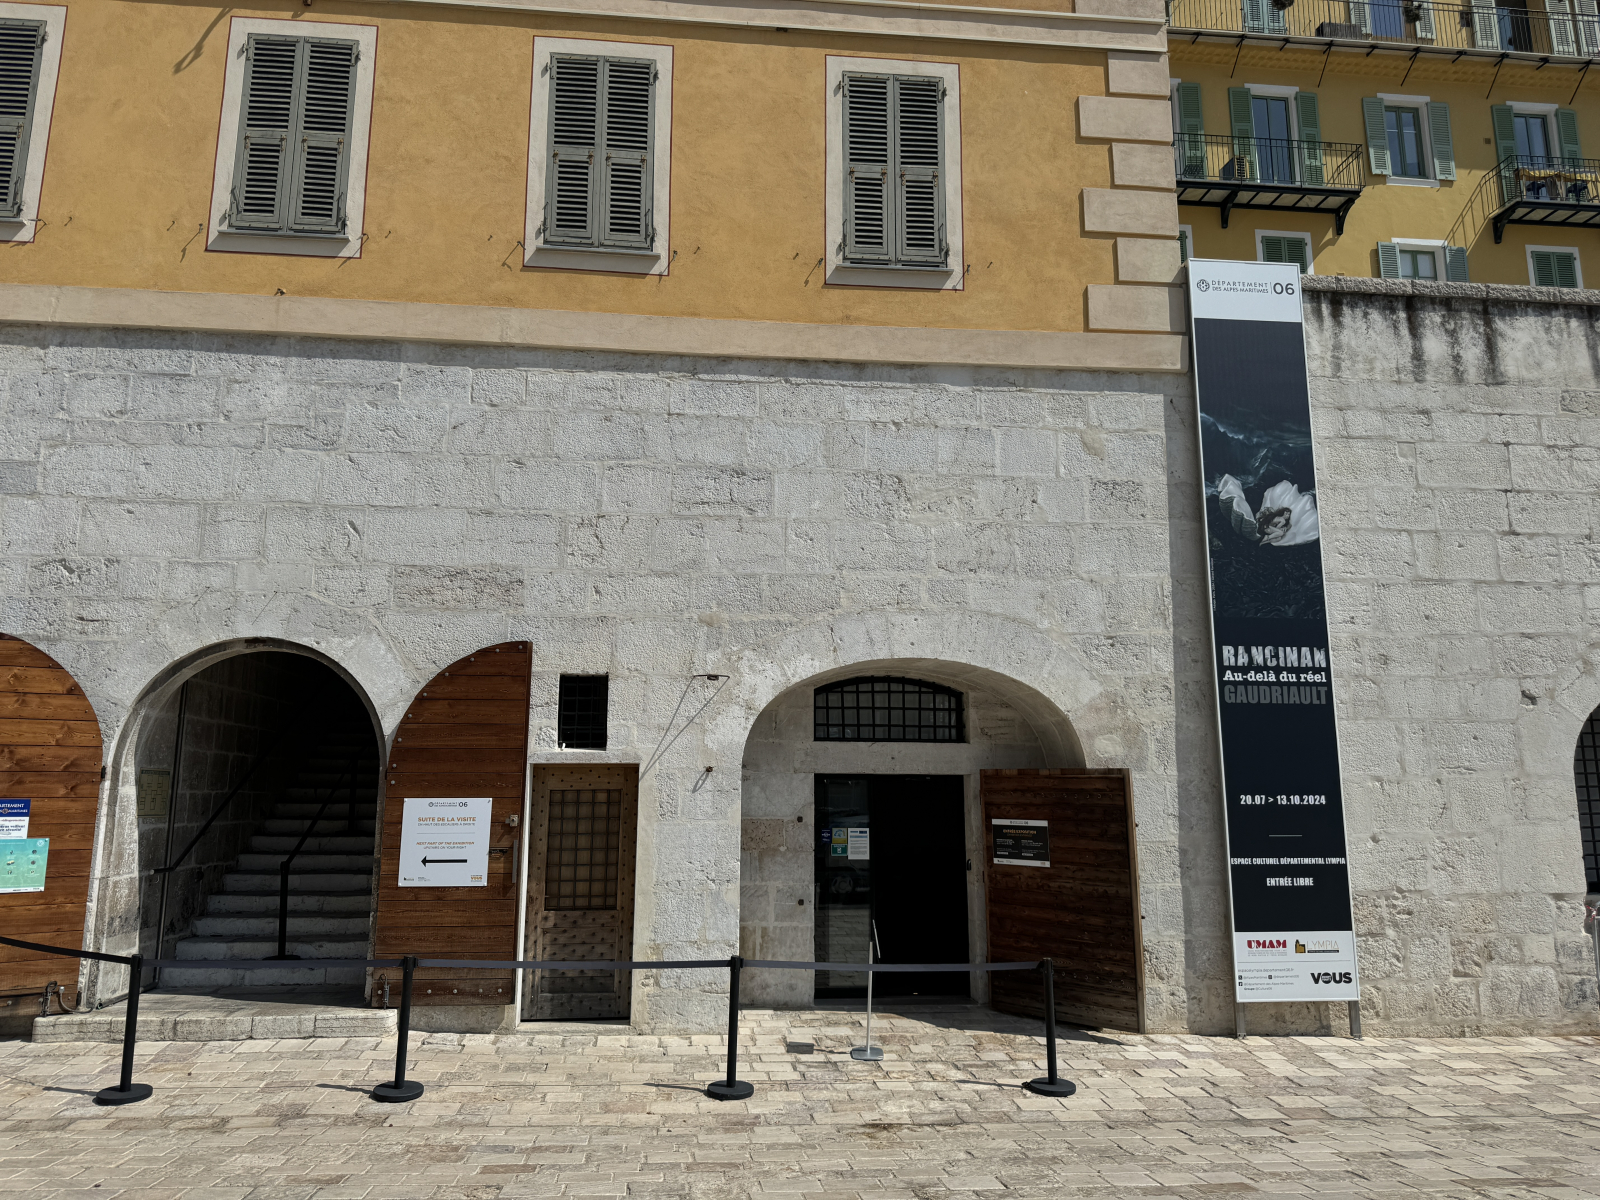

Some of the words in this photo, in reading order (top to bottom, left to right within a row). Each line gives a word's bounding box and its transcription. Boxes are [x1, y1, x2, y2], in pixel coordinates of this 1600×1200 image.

[1211, 279, 1268, 288] DÉPARTEMENT
[1273, 282, 1295, 295] 06
[1222, 645, 1327, 668] RANCINAN
[1222, 670, 1277, 682] Au-delà
[1279, 671, 1298, 682] du
[1299, 671, 1327, 683] réel
[1223, 684, 1328, 705] GAUDRIAULT
[1239, 794, 1266, 805] 20.07
[1276, 794, 1326, 805] 13.10.2024
[1230, 857, 1252, 865] ESPACE
[1252, 857, 1280, 865] CULTUREL
[1280, 856, 1325, 865] DÉPARTEMENTAL
[1325, 857, 1346, 865] LYMPIA
[1266, 876, 1293, 887] ENTRÉE
[1293, 877, 1314, 887] LIBRE
[1247, 939, 1287, 949] UMAM
[1306, 940, 1340, 950] LYMPIA
[1310, 972, 1353, 984] VOUS
